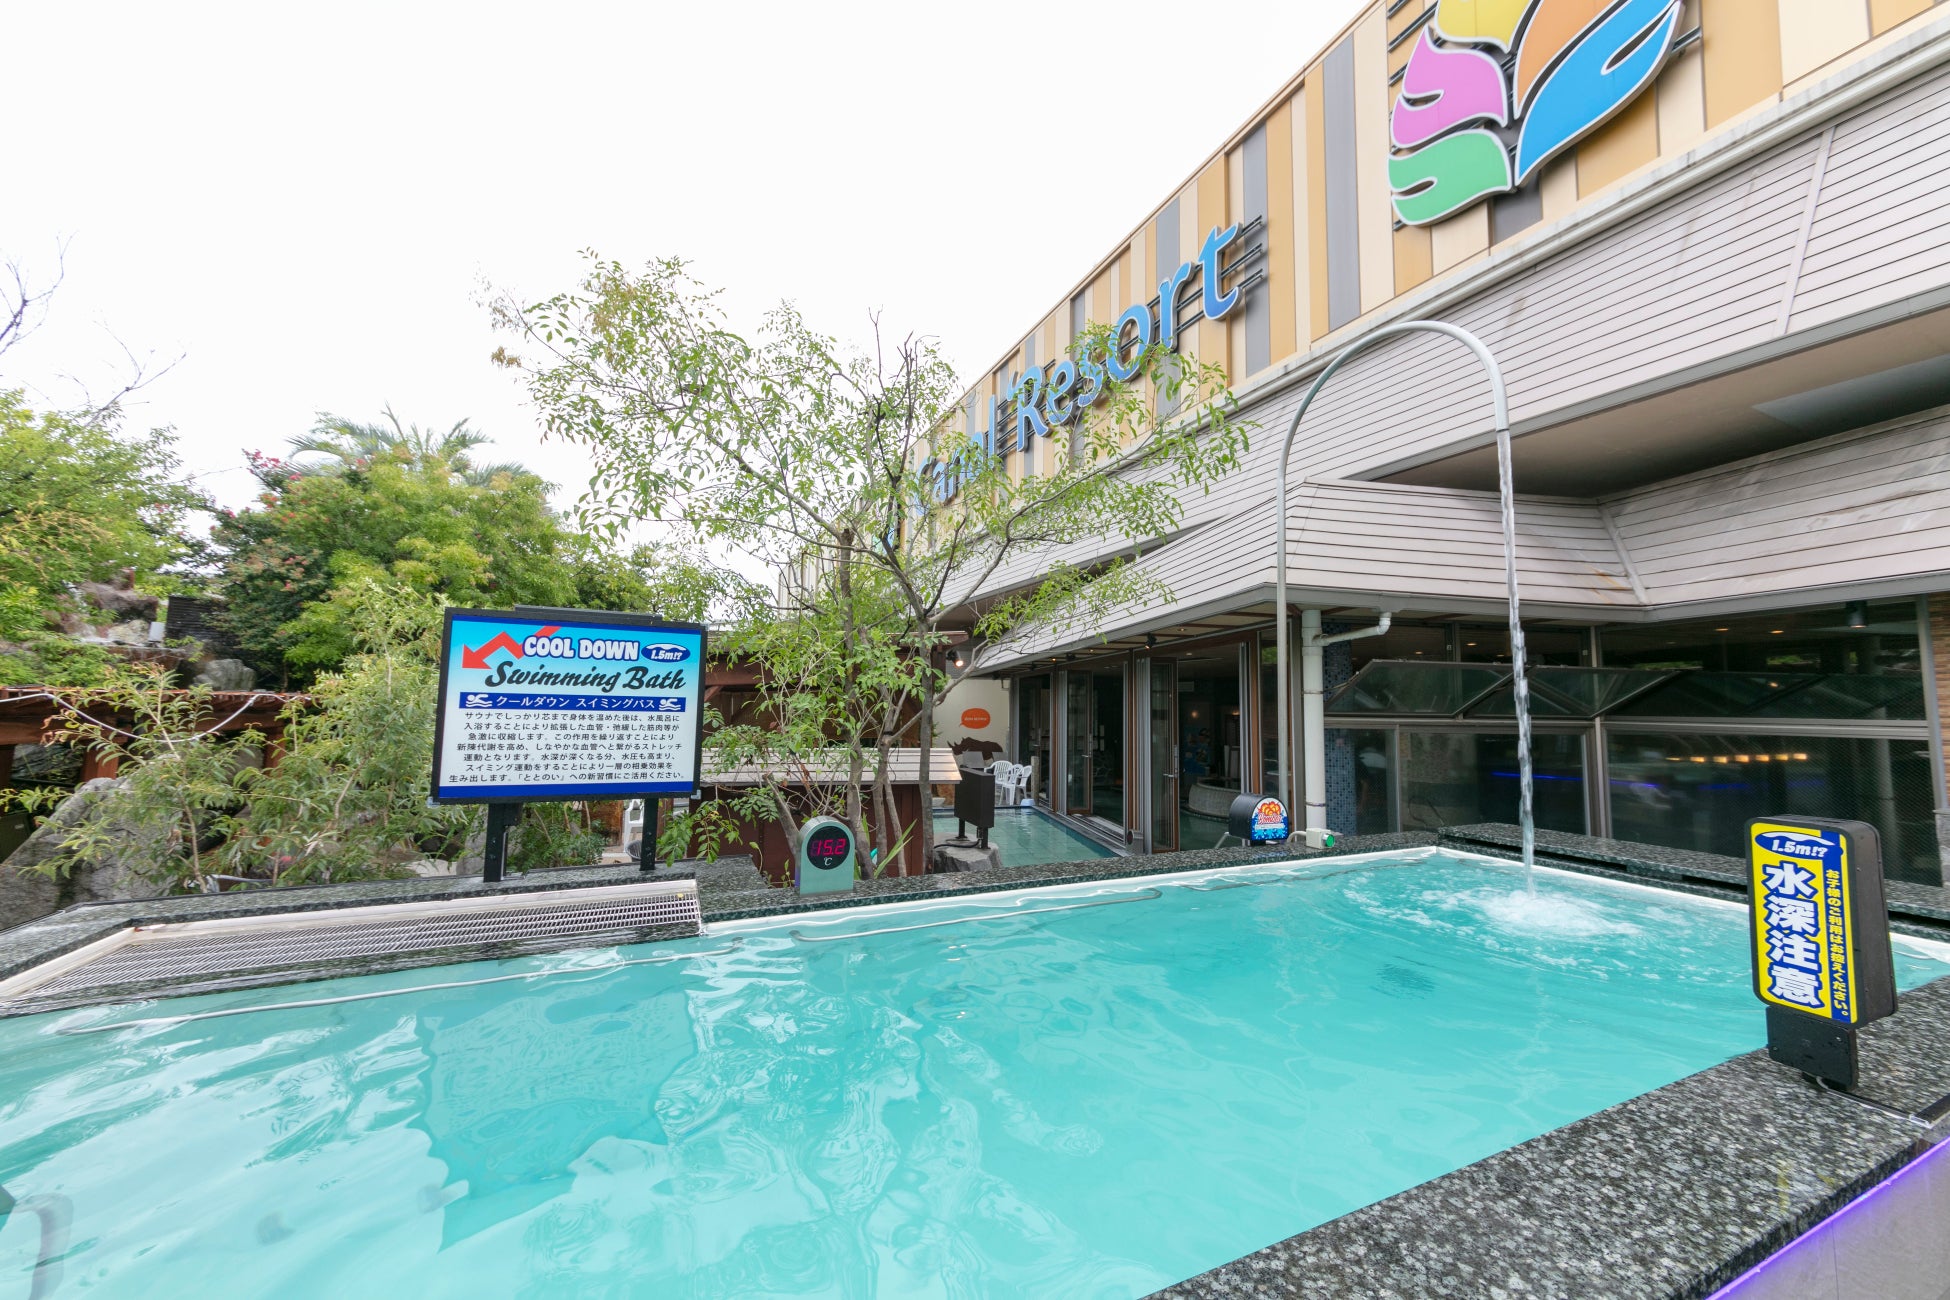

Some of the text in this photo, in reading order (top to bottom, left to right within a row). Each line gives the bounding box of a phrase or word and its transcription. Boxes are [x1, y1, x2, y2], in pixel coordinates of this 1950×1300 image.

[1007, 221, 1244, 452] Resort
[523, 635, 639, 661] COOL DOWN
[485, 661, 687, 693] Swimming Bath
[496, 695, 655, 709] クールダウン スイミングバス
[1771, 839, 1829, 858] 1.5m!?
[1764, 862, 1822, 1007] 水深注意
